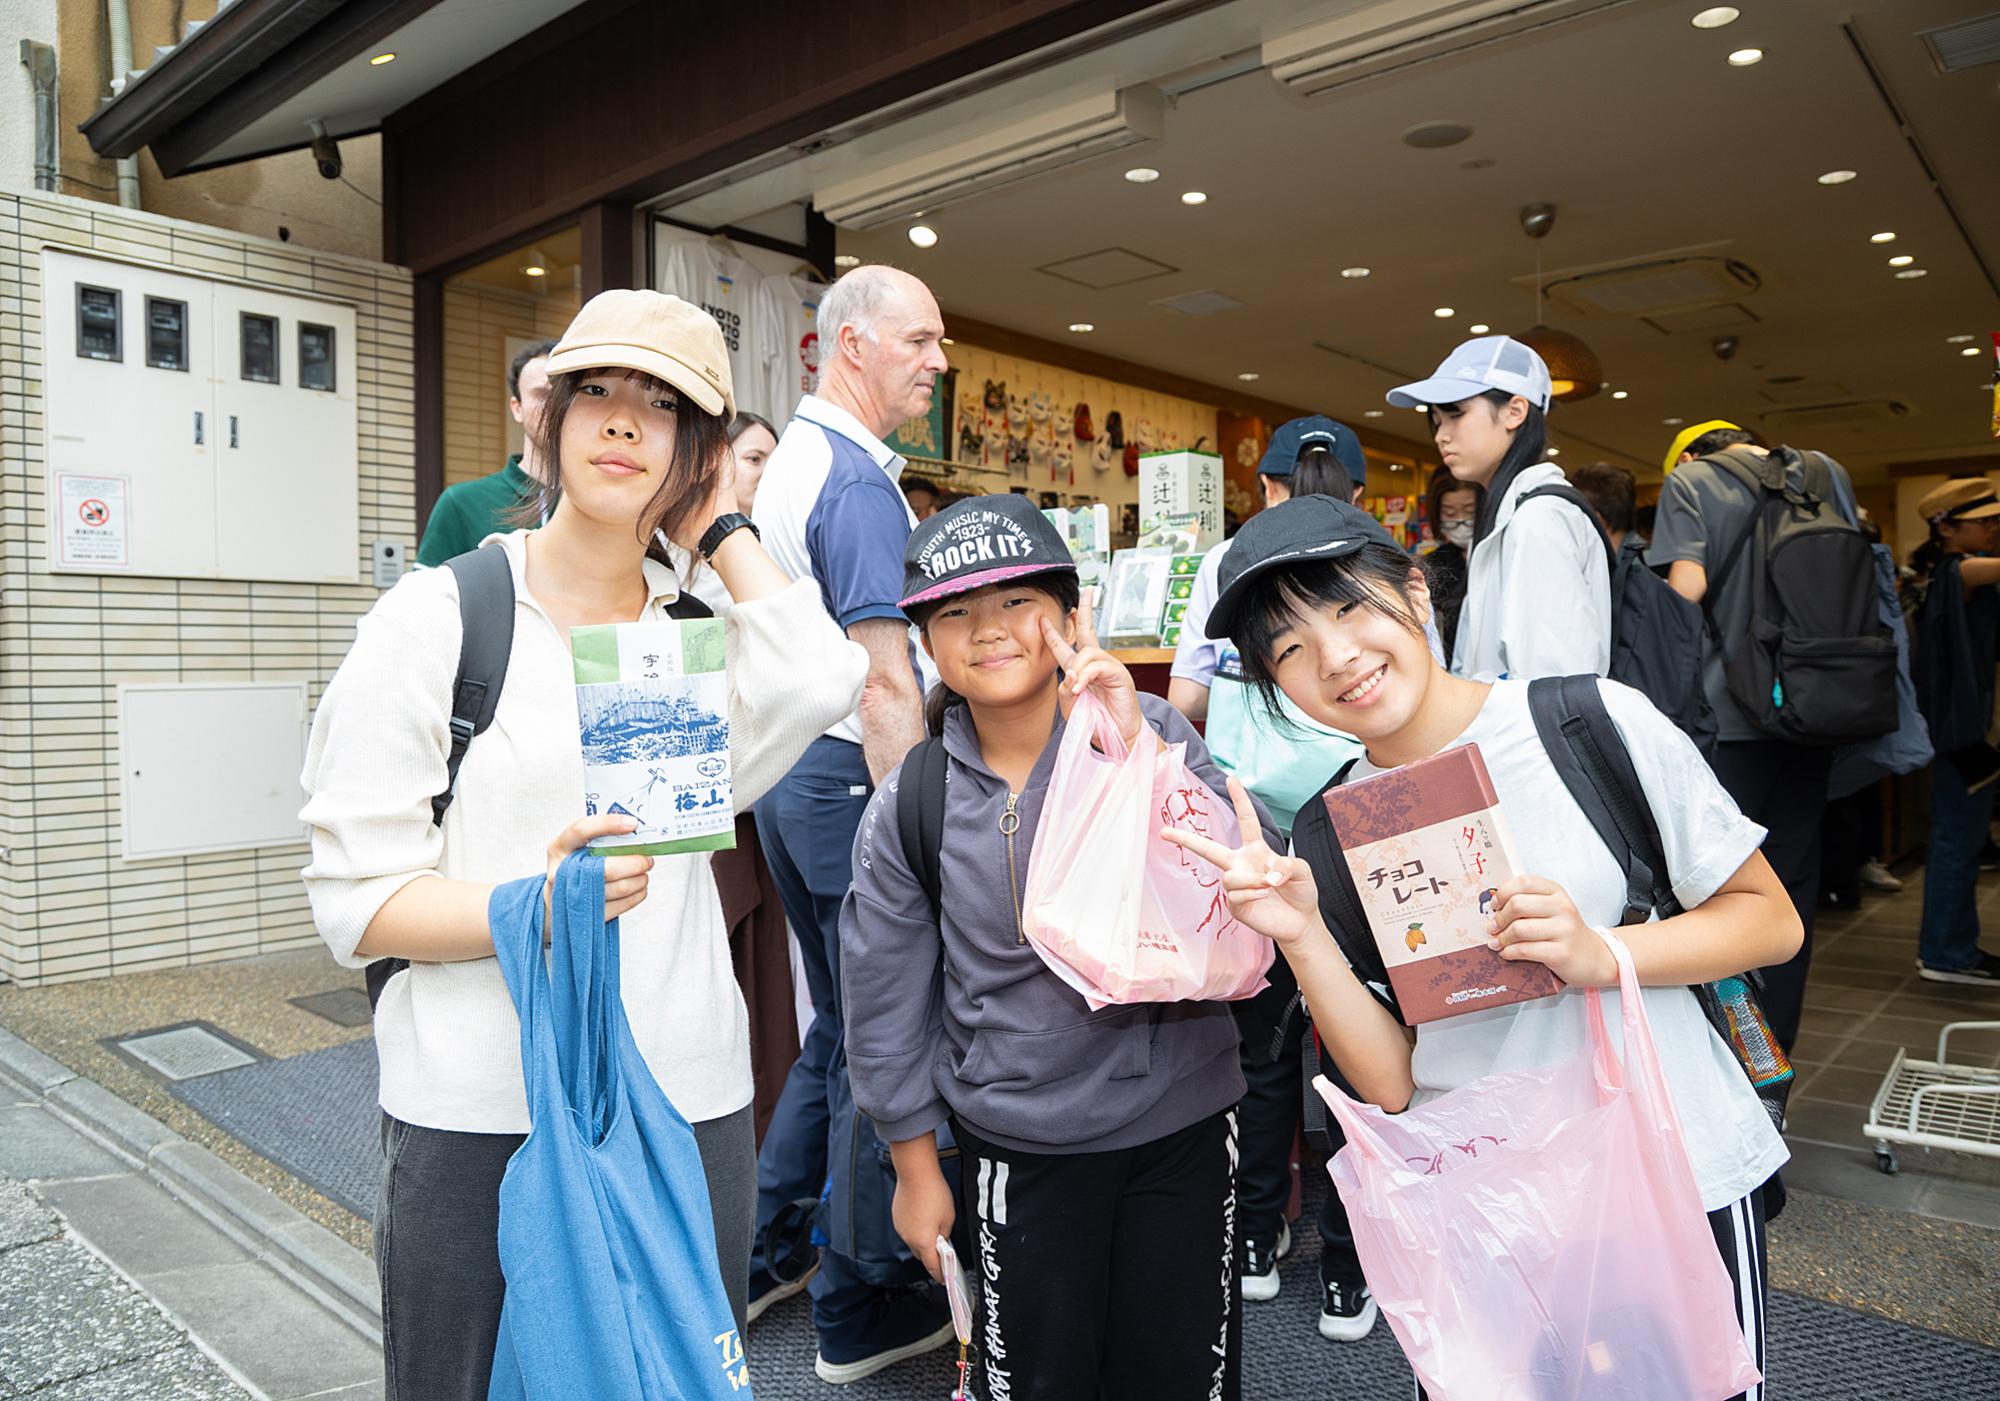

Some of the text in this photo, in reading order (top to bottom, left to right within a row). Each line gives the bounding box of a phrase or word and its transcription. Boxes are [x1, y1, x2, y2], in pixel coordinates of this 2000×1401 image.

[917, 510, 1027, 564] YOUTH MUSIC MY TIME
[930, 533, 1021, 579] ROCK IT
[675, 788, 733, 813] 梅山
[1367, 859, 1425, 890] チョコ
[1392, 876, 1450, 905] レート
